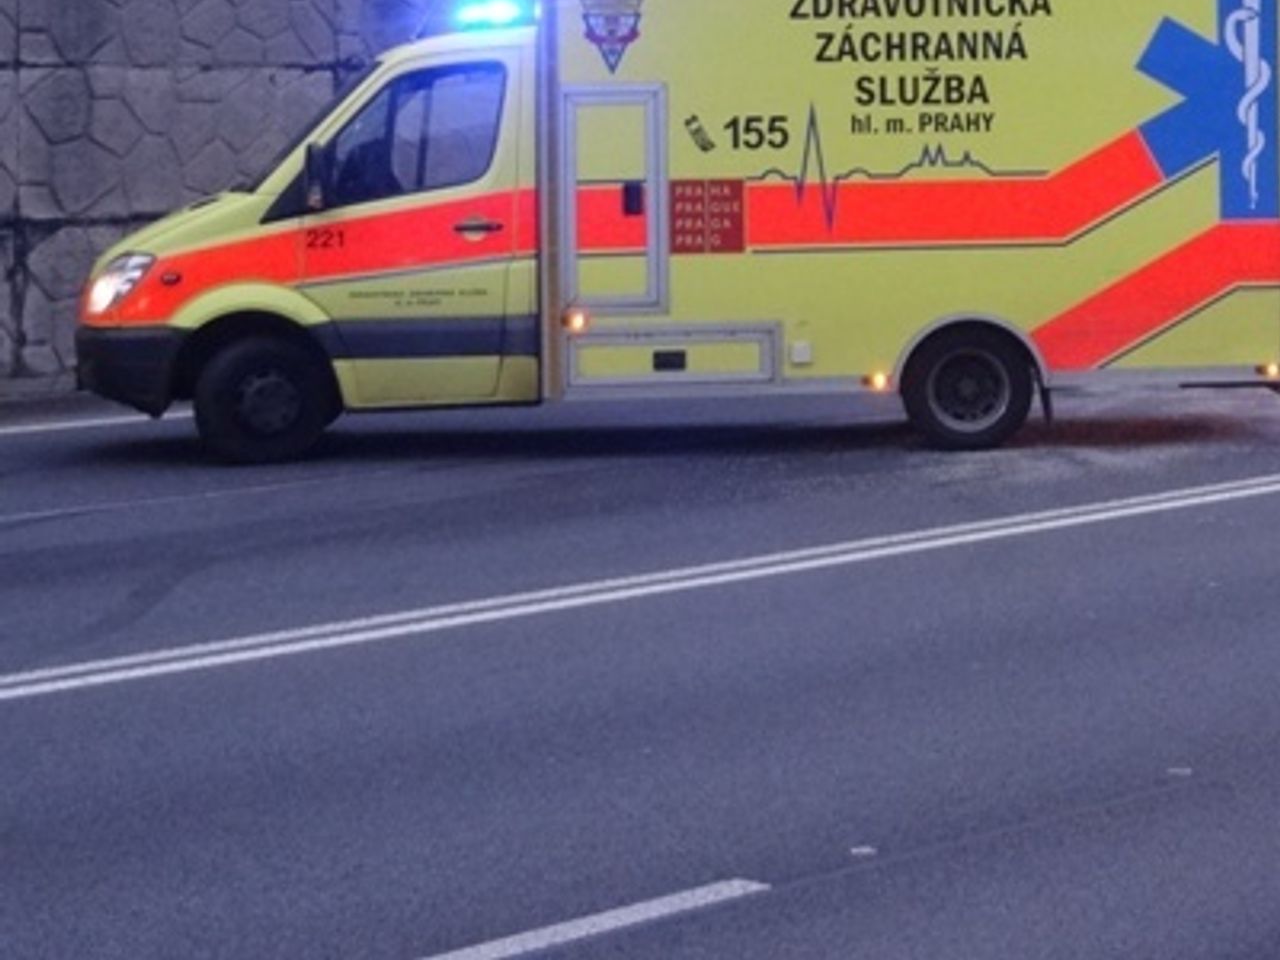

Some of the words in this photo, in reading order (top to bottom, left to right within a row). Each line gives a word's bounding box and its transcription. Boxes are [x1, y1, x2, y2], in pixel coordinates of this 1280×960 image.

[815, 22, 1028, 62] ZÁCHRANNÁ
[854, 67, 990, 106] SLUŽBA
[723, 115, 789, 149] 155
[851, 114, 879, 134] hl.
[886, 117, 912, 134] m.
[918, 112, 995, 133] PRAHY
[306, 229, 345, 248] 221
